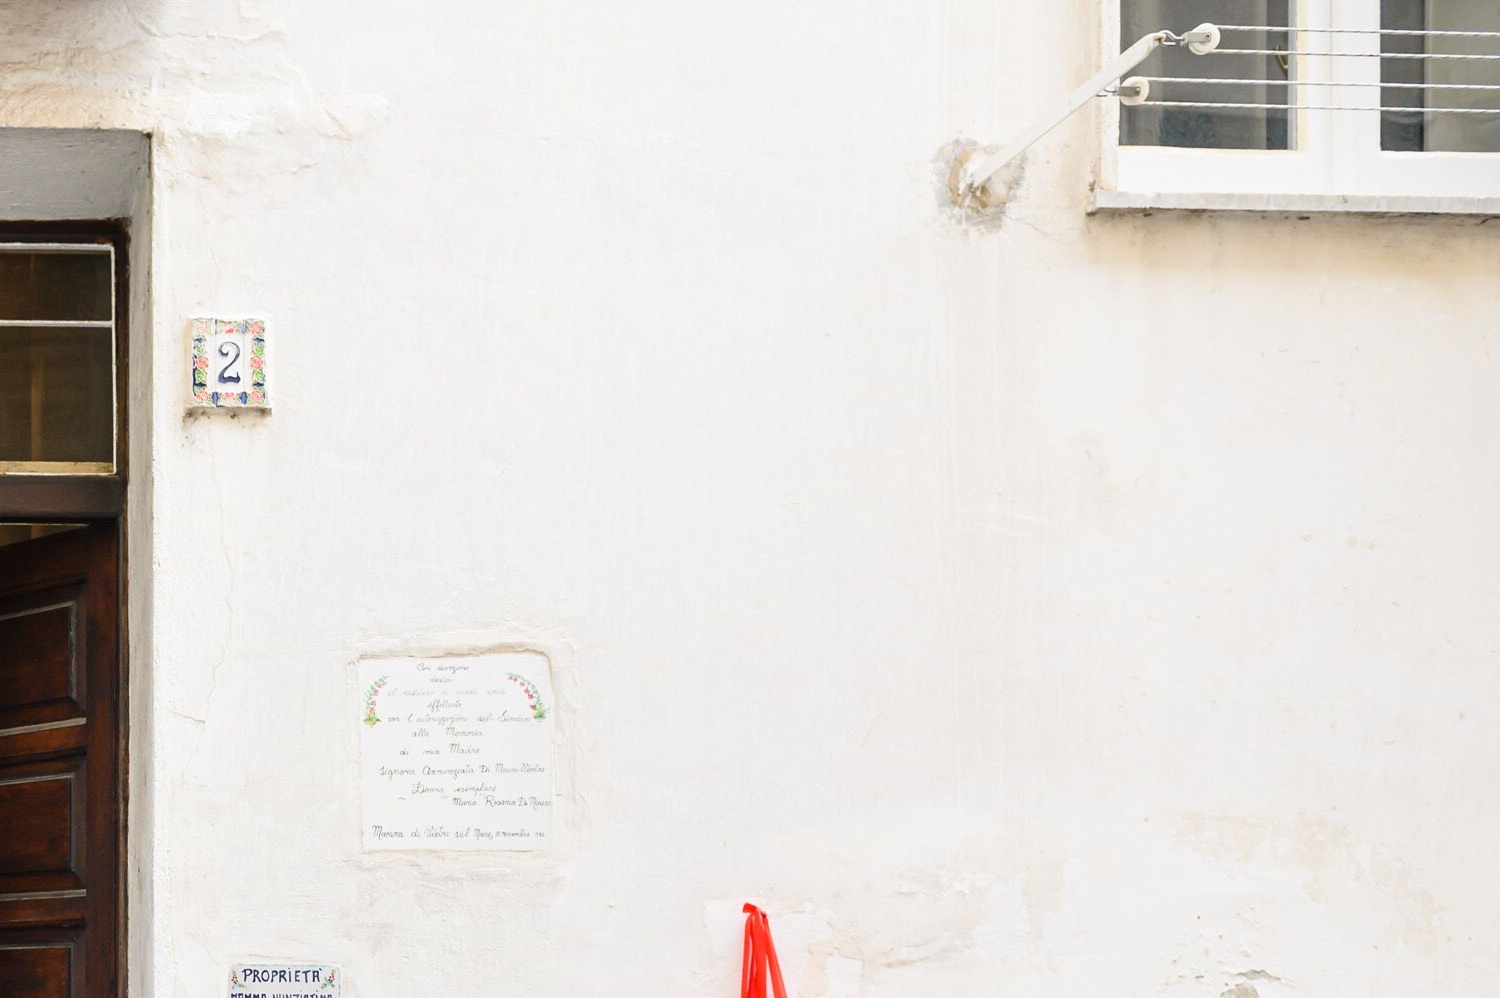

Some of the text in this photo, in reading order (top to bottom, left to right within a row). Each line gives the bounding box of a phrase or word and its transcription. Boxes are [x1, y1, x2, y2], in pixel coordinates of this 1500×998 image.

[218, 341, 241, 384] 2
[449, 743, 480, 754] Madre
[452, 797, 477, 806] Maria
[484, 794, 516, 807] Rosaria
[372, 825, 404, 840] Marina
[411, 827, 421, 838] di
[425, 825, 450, 838] Vietri
[454, 827, 470, 838] sul
